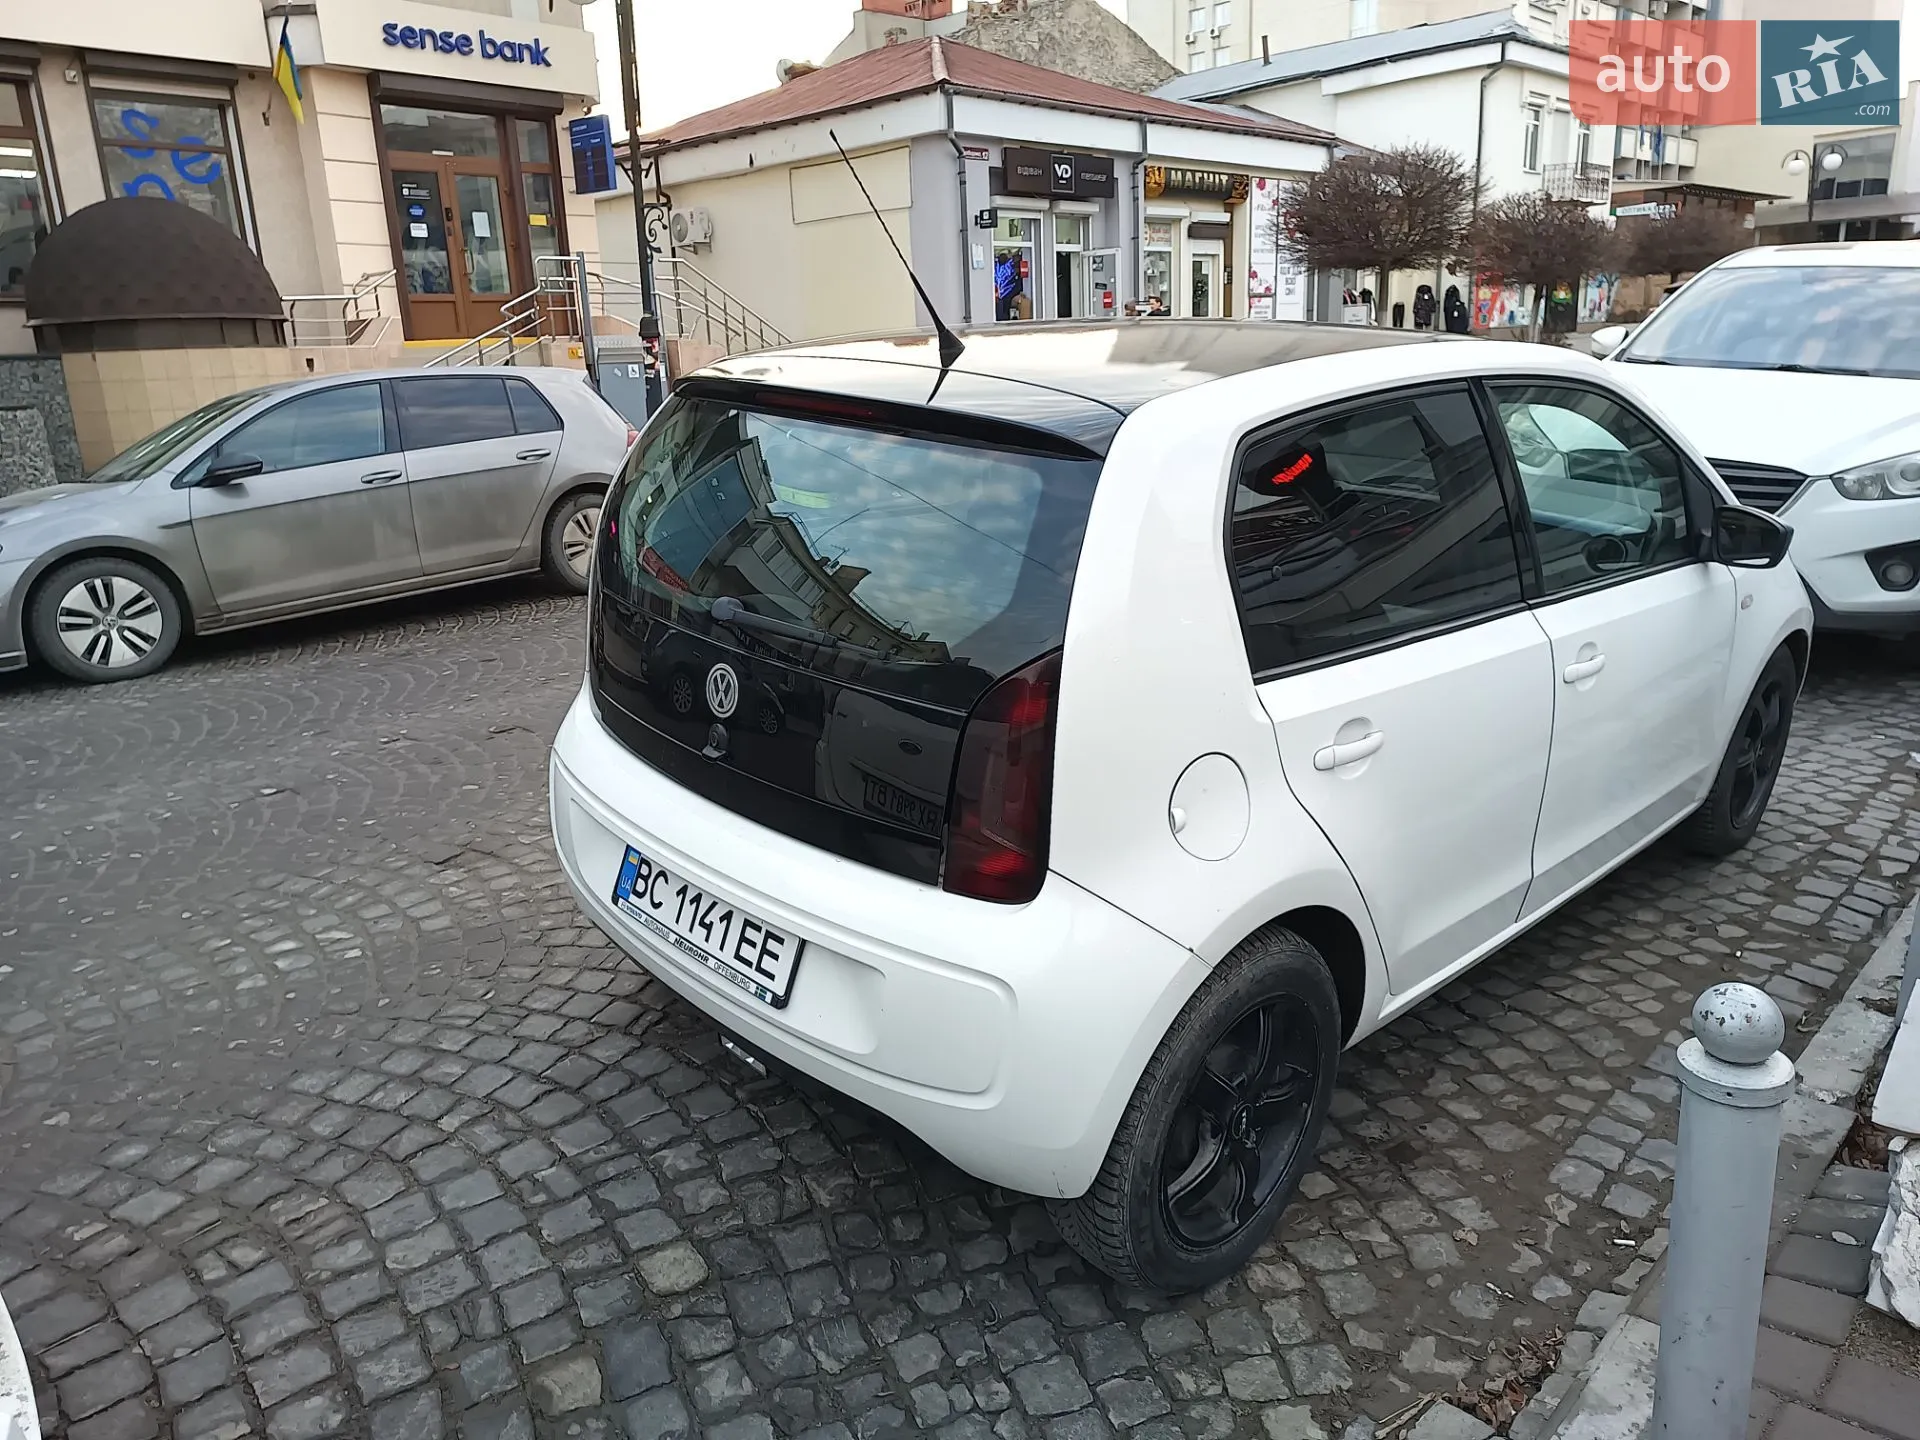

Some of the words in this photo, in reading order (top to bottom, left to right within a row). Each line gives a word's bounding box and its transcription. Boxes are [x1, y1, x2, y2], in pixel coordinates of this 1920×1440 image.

[382, 21, 474, 56] sense
[479, 29, 552, 68] bank
[1170, 169, 1229, 192] МАГНІТ
[621, 874, 631, 890] UA
[631, 856, 670, 911] BC
[674, 883, 735, 953] 1141
[734, 918, 785, 982] EE
[644, 916, 671, 940] AUTOHAUS
[673, 936, 710, 964] NEUROHR
[713, 961, 752, 990] OFFENBURG
